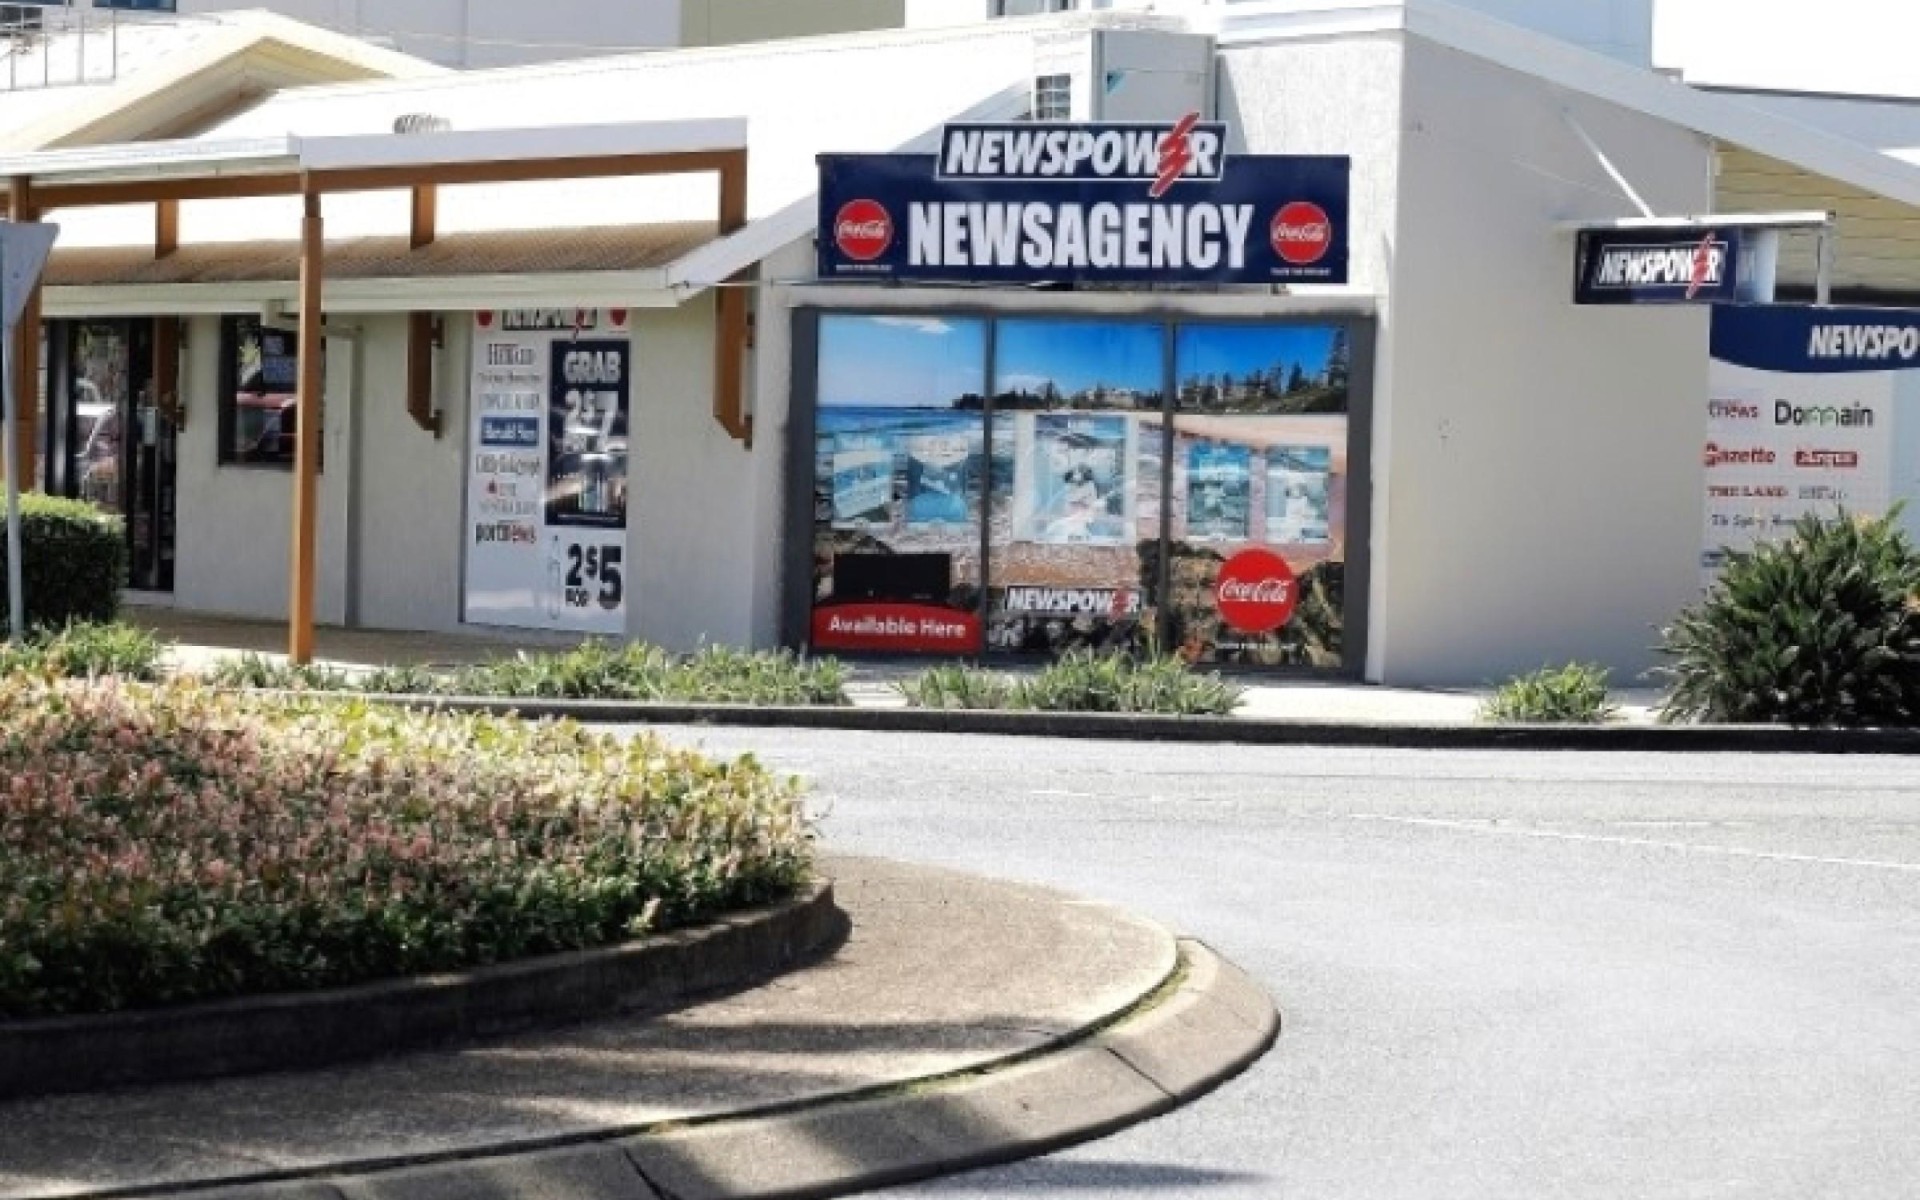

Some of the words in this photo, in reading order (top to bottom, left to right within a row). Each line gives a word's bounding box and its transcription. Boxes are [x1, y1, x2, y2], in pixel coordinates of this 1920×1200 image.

[907, 201, 1255, 269] NEWSAGENCY
[563, 351, 621, 384] GRAB
[1775, 400, 1873, 426] Domain
[1219, 577, 1292, 604] Coca-Cola
[827, 613, 917, 637] Available
[920, 618, 967, 638] Here
